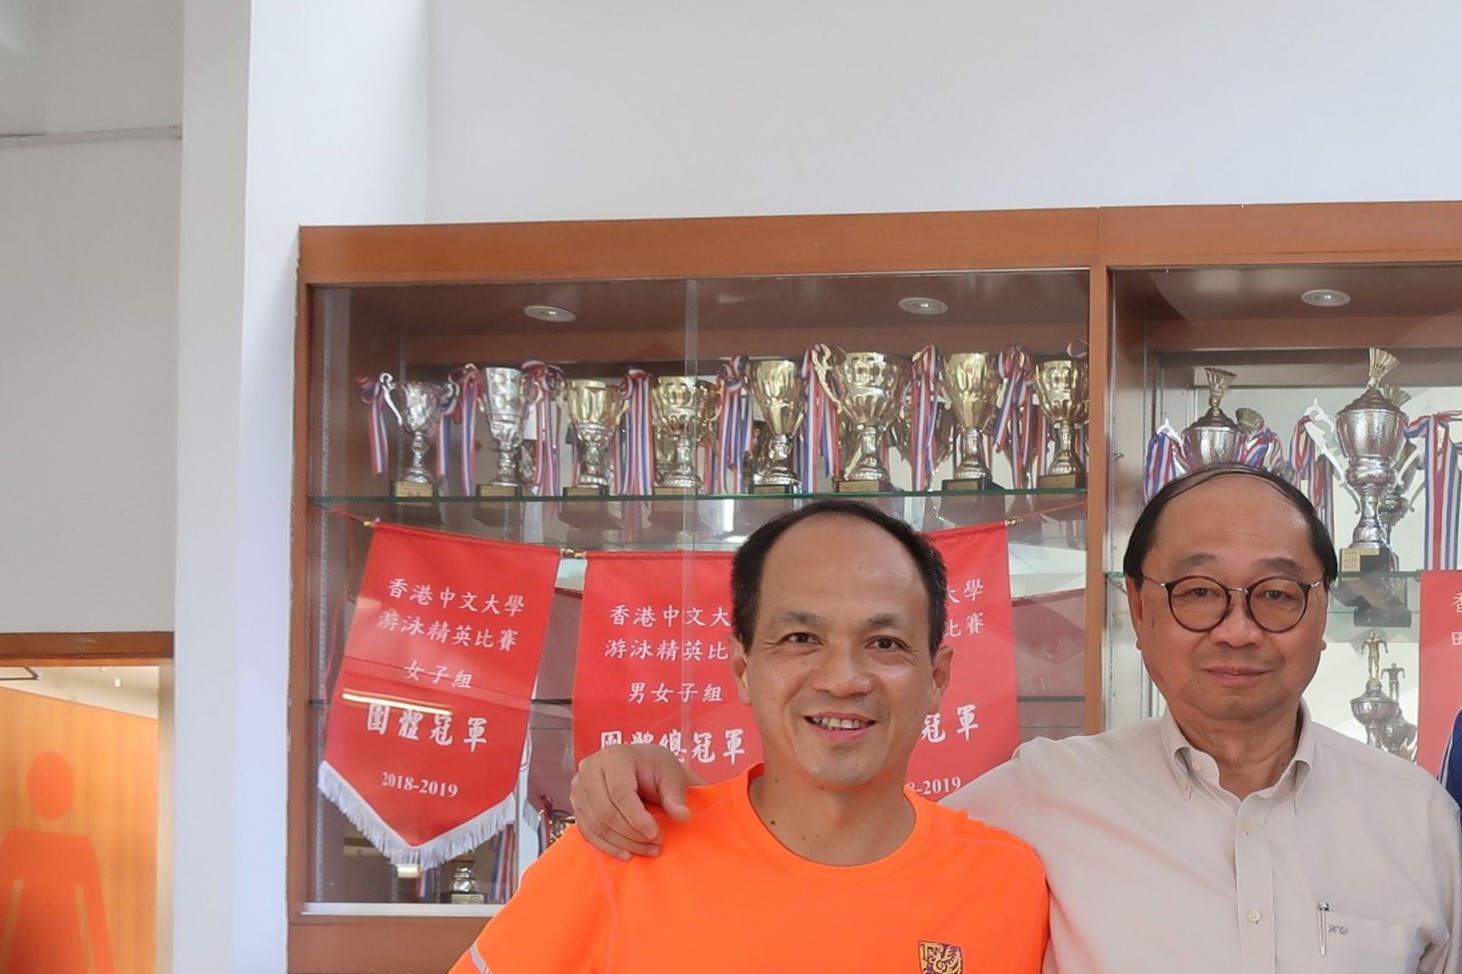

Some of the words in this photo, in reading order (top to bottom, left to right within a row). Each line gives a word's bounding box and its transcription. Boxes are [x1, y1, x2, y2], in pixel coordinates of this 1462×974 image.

[388, 578, 525, 618] 香港中文大學
[377, 609, 519, 652] 游泳精英比賽
[403, 660, 473, 689] 女子組
[628, 682, 723, 704] 男女子組
[920, 704, 979, 743] 冠軍
[381, 771, 459, 798] 2018-2019
